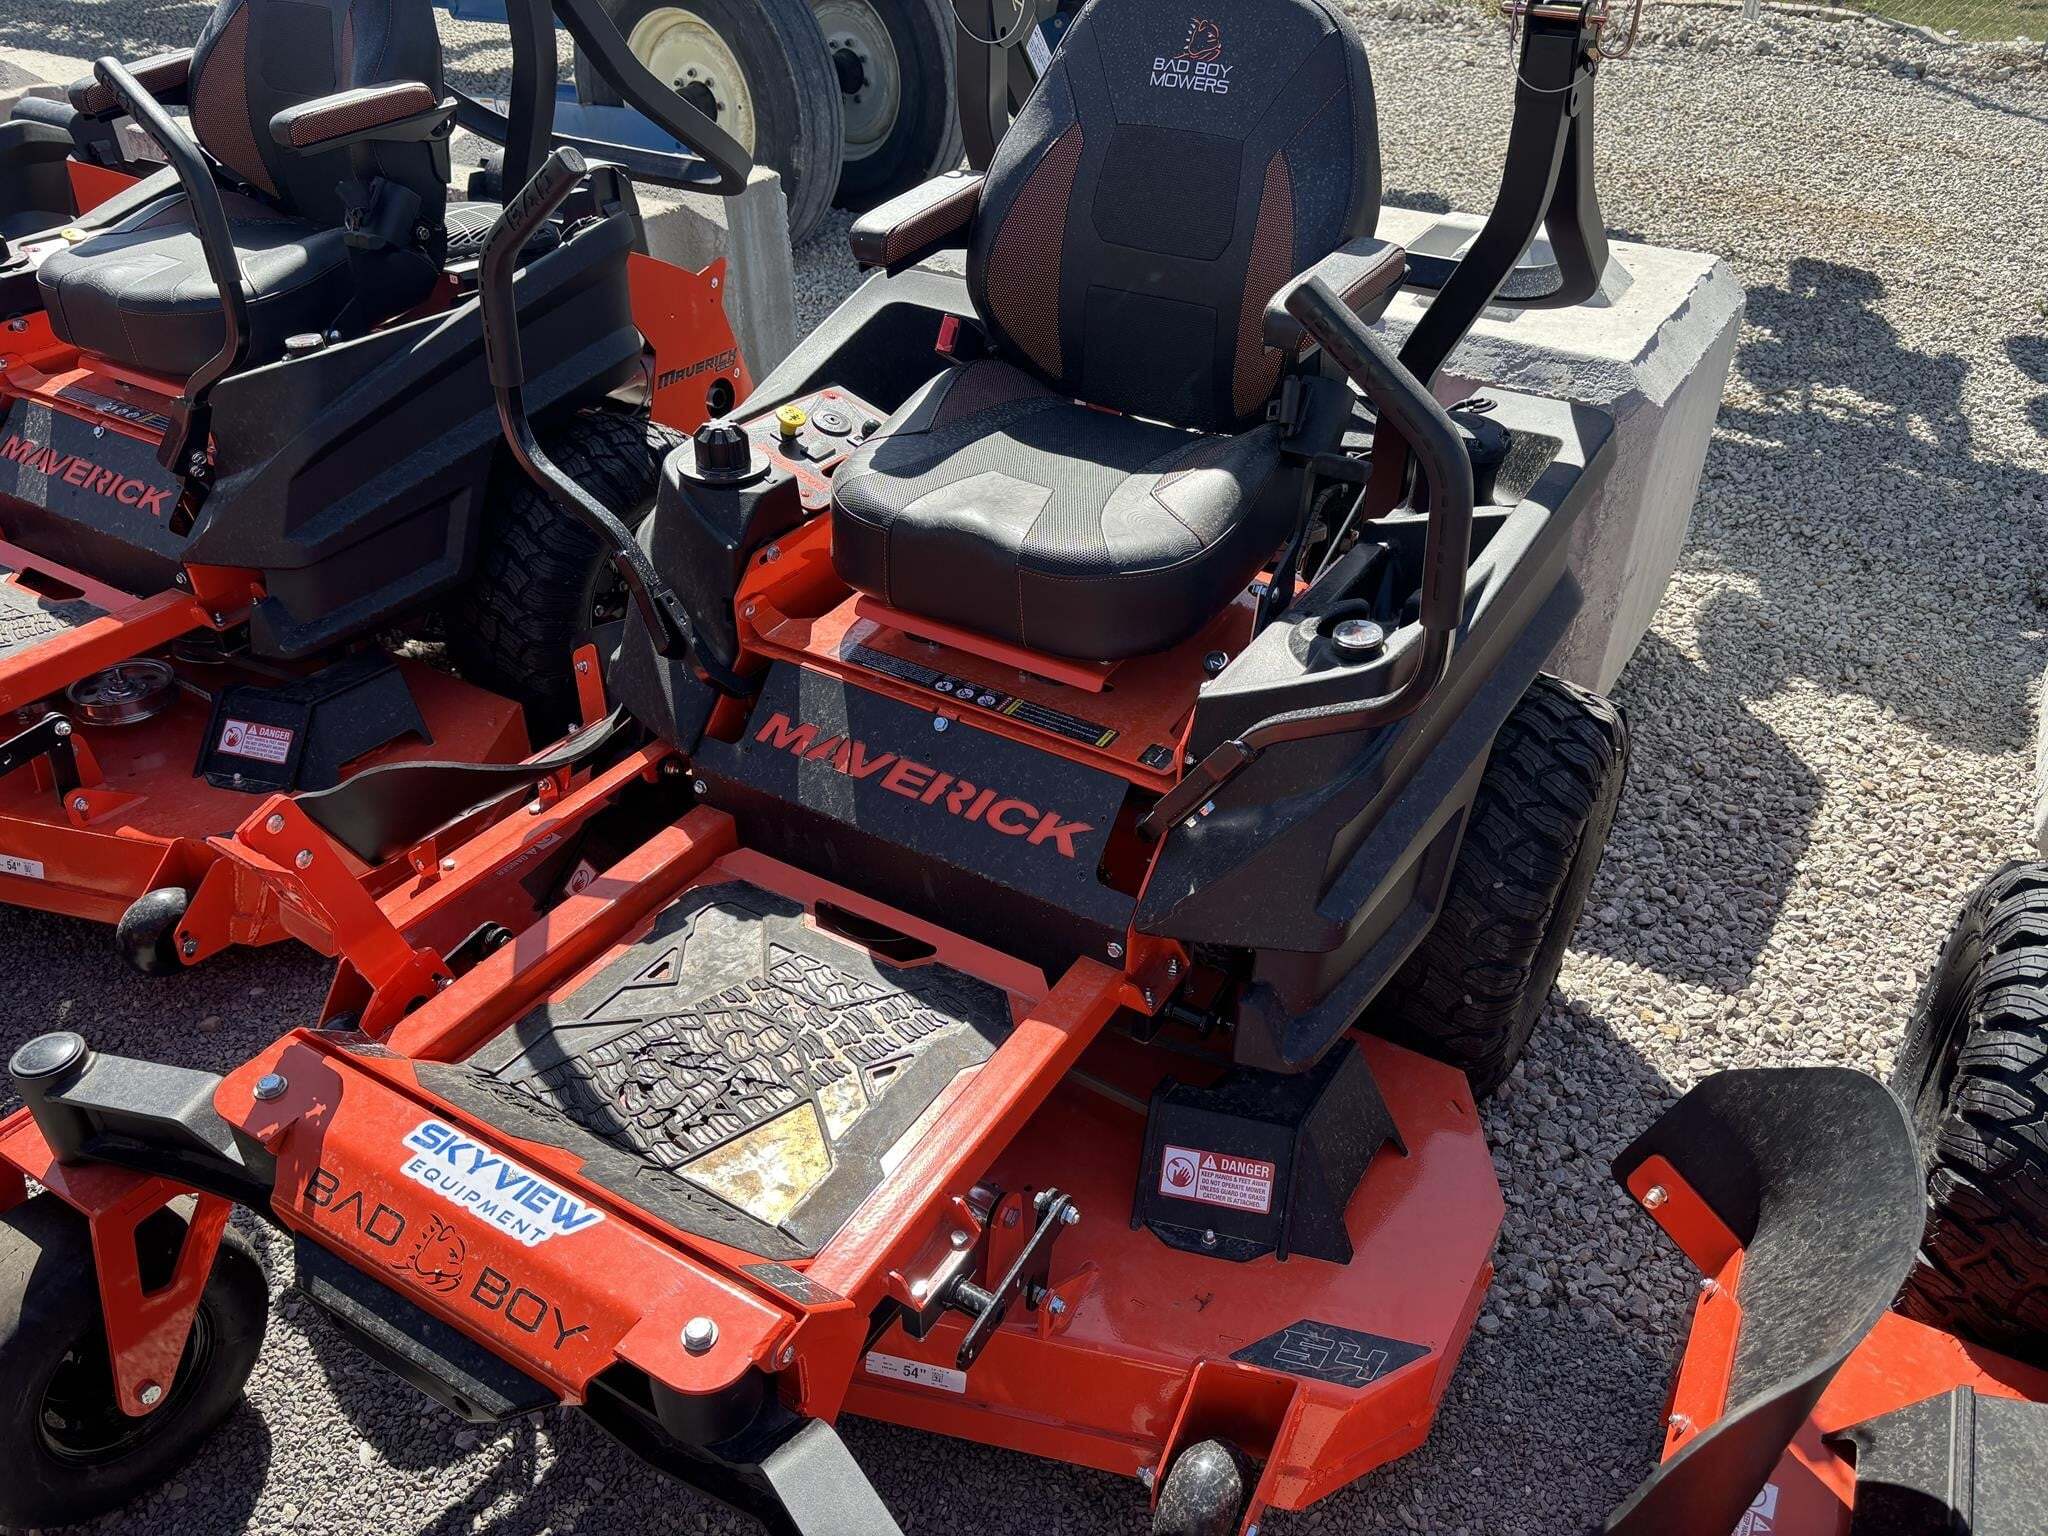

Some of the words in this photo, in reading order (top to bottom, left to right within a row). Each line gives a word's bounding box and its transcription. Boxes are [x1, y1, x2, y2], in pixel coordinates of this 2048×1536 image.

[1152, 57, 1190, 73] BAD
[1195, 61, 1234, 79] BOY
[1149, 71, 1230, 94] MOWERS
[657, 347, 738, 390] MAVERICK
[0, 432, 173, 518] MAVERICK
[258, 726, 291, 741] DANGER
[754, 712, 1095, 858] MAVERICK
[410, 1122, 600, 1231] SKYVIEW
[1214, 1173, 1232, 1181] HANDS
[1221, 1158, 1270, 1178] DANGER
[1200, 1185, 1220, 1194] UNLESS
[1220, 1189, 1239, 1197] GUARD
[1248, 1193, 1266, 1201] GRASS
[1202, 1192, 1226, 1201] CATCHER
[1221, 1182, 1245, 1191] OPERATE
[1245, 1186, 1266, 1194] MOWER
[407, 1158, 548, 1242] EQUIPMENT
[303, 1166, 407, 1247] BAD
[470, 1265, 590, 1351] BOY
[1273, 1329, 1389, 1381] 54
[902, 1364, 927, 1379] 54"
